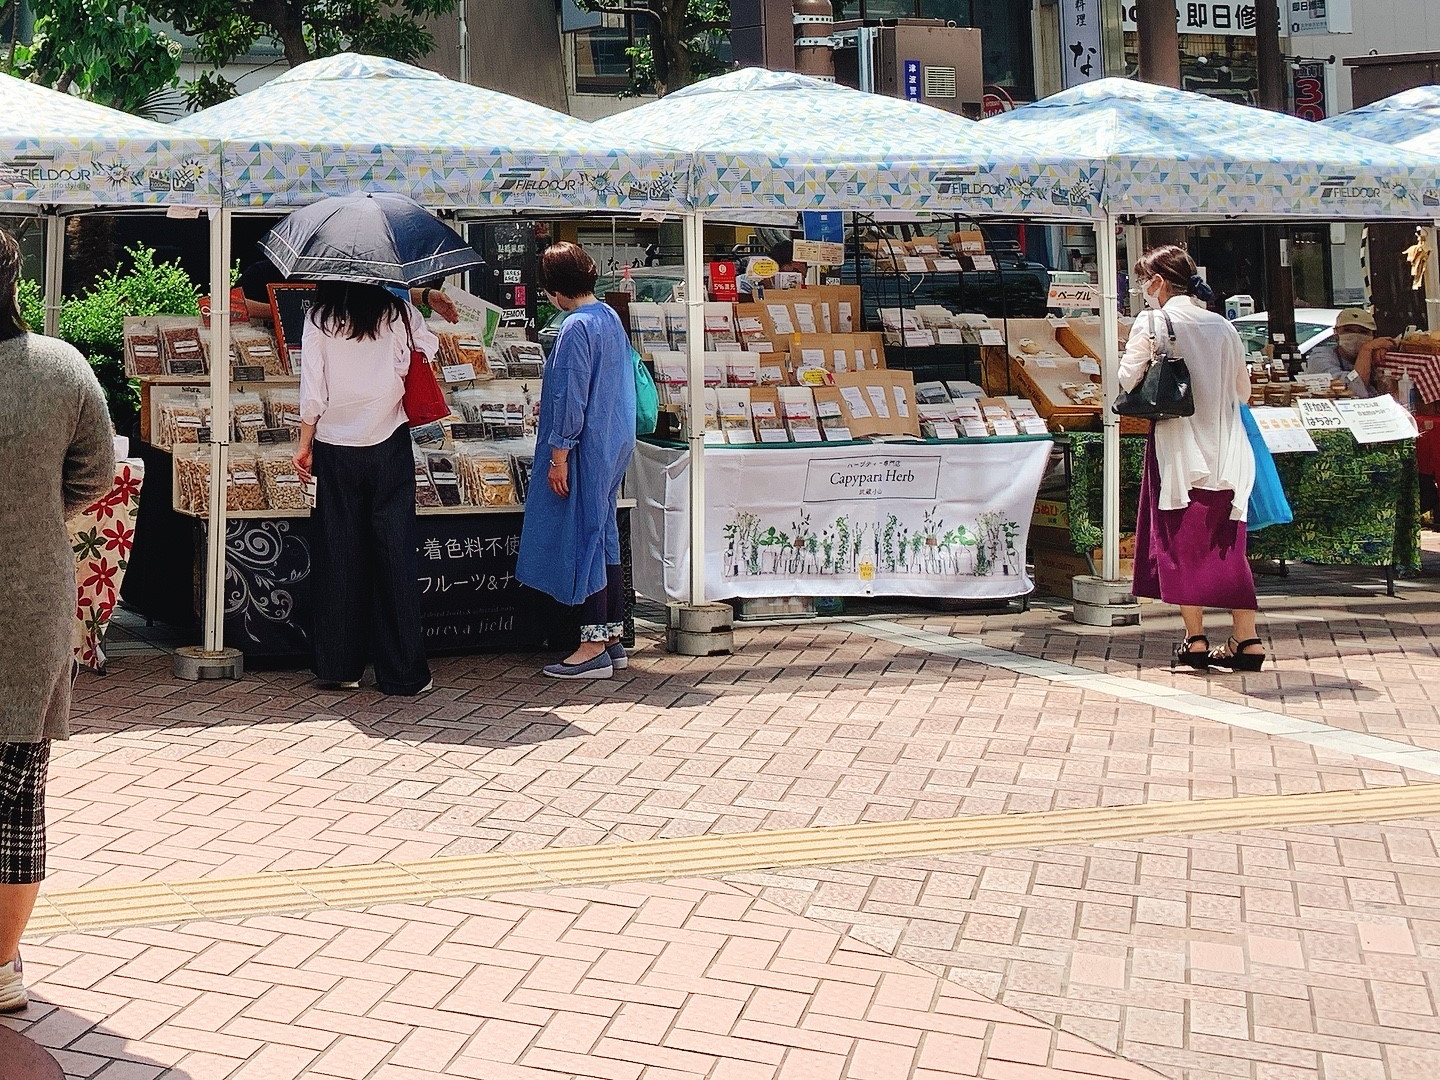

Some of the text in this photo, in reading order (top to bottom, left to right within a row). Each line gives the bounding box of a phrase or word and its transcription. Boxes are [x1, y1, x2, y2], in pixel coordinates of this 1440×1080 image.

[1068, 41, 1098, 78] な
[20, 169, 91, 181] FIELDOOR
[515, 179, 576, 191] FIELDOOR
[951, 182, 1005, 195] FIELDOOR
[1333, 187, 1381, 198] FIELDOOR
[1057, 290, 1092, 301] ベーグル
[1306, 416, 1341, 427] はちみつ
[885, 469, 915, 483] Herb
[416, 571, 524, 594] フルーツ&ナ
